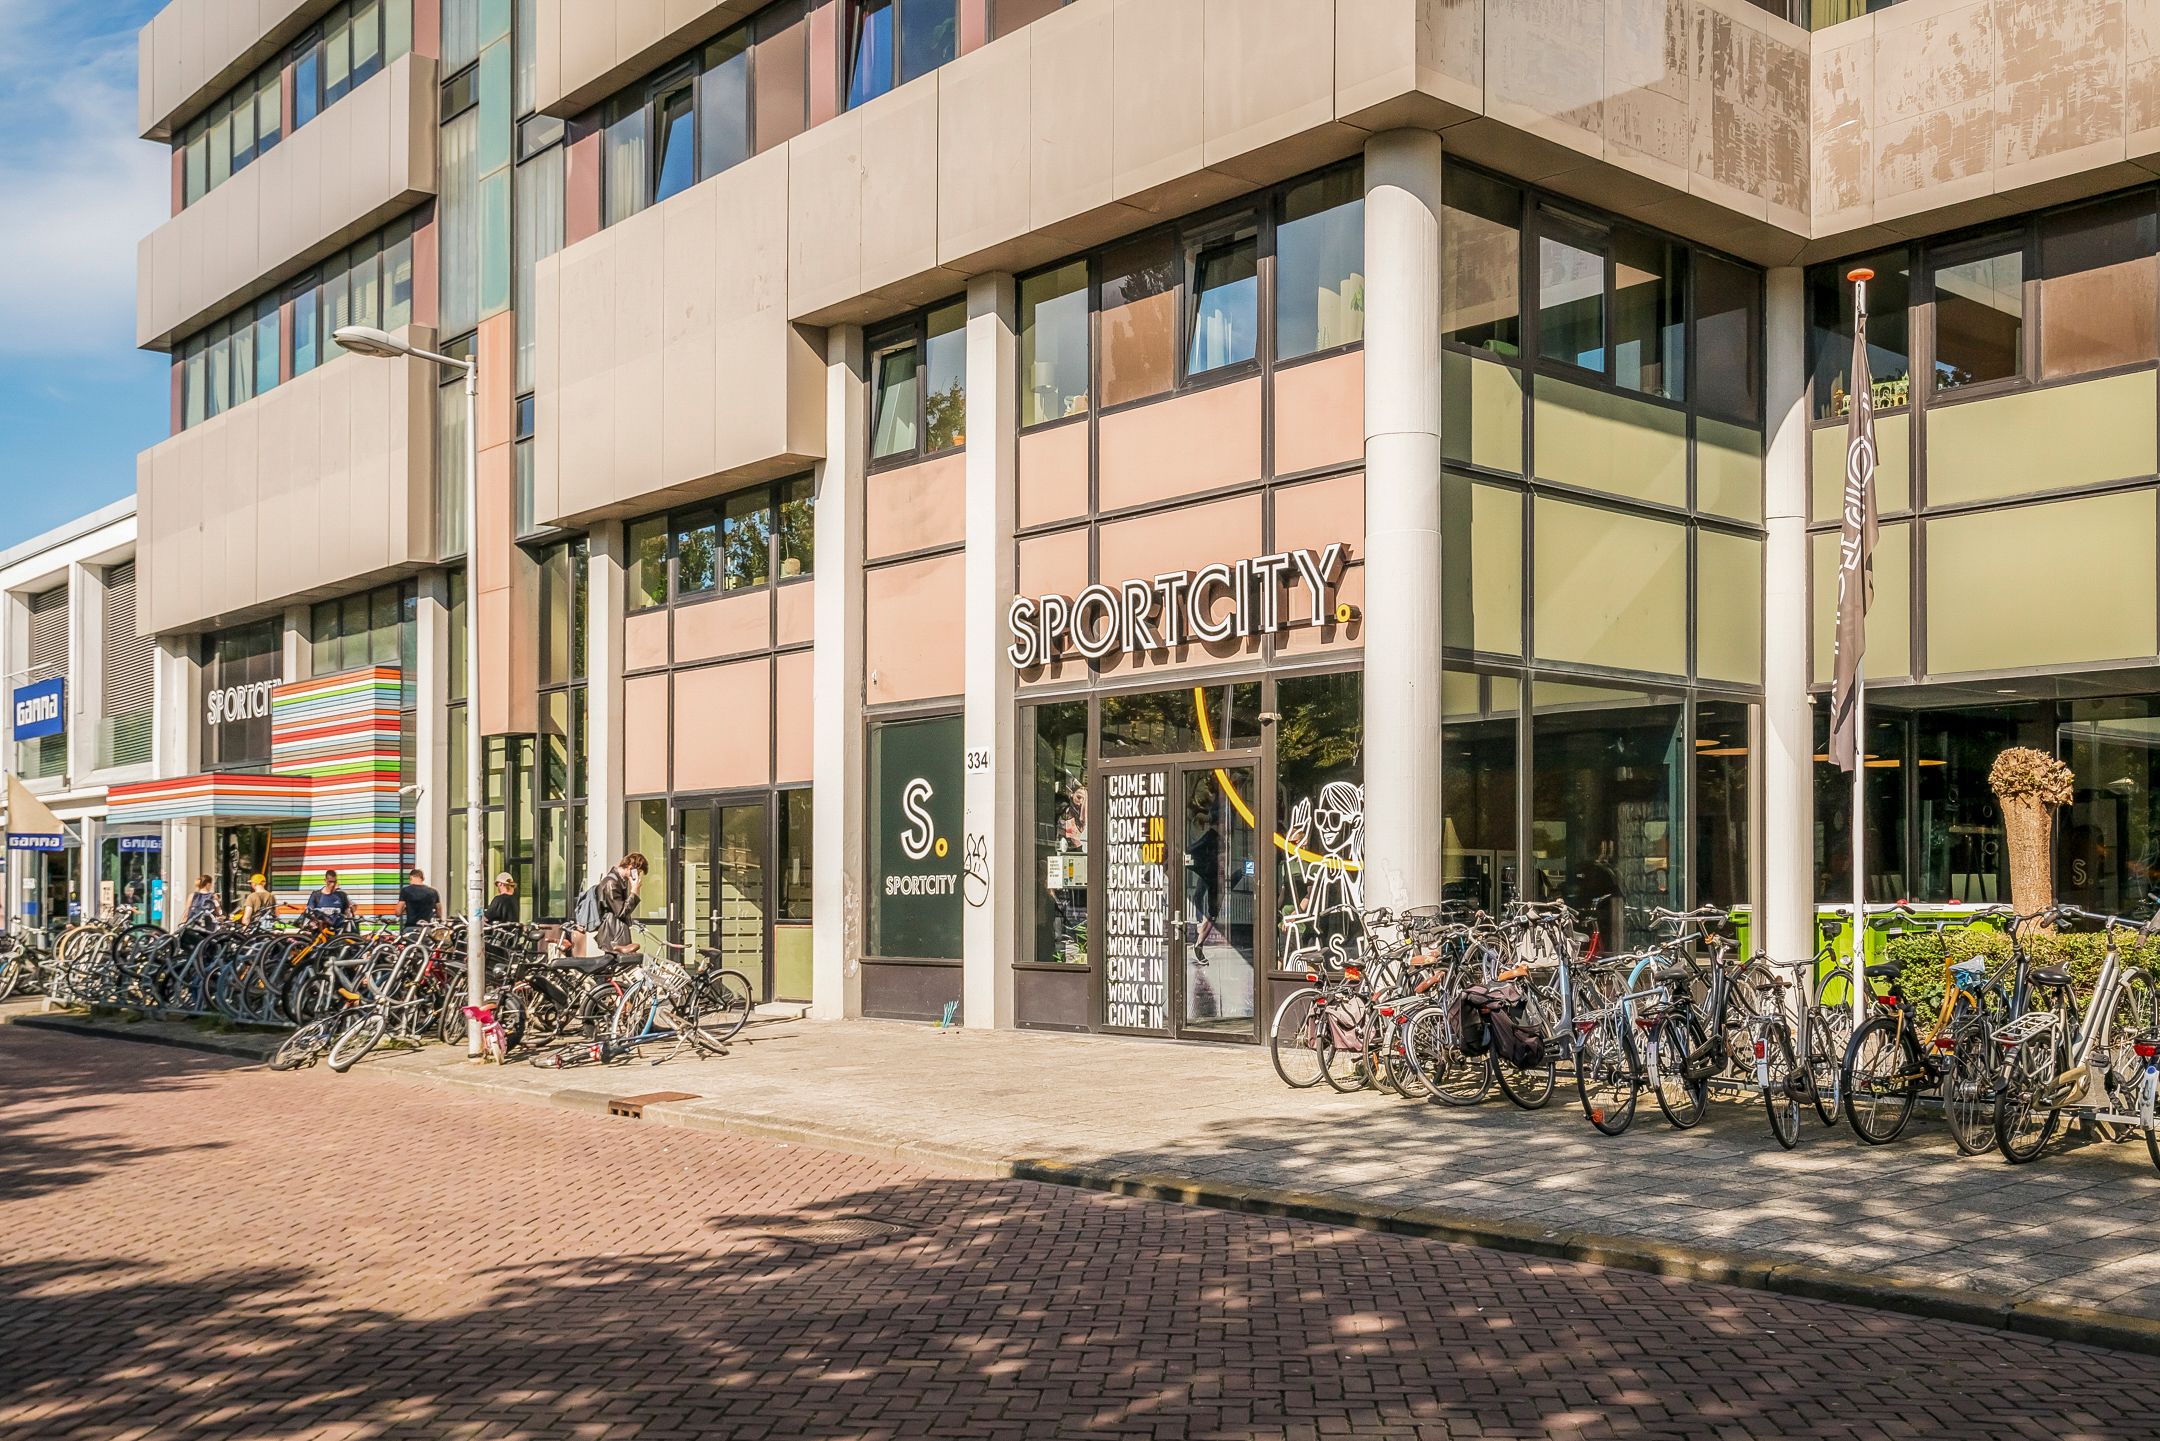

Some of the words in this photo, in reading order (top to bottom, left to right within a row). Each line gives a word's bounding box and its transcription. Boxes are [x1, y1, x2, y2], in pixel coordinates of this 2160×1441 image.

[207, 678, 282, 725] SPORTCI
[967, 751, 989, 770] 334
[1109, 774, 1147, 797] COME
[1150, 772, 1165, 795] IN
[1108, 797, 1140, 818] WORK
[1142, 795, 1165, 817] OUT
[1109, 818, 1147, 843] COME
[1149, 817, 1165, 842] IN
[1108, 843, 1140, 864] WORK
[1142, 843, 1165, 864] OUT
[885, 874, 958, 896] SPORTCITY
[1108, 864, 1147, 889] COME
[1149, 864, 1164, 889] IN
[1107, 889, 1140, 910] WORK
[1142, 890, 1164, 910] OUT
[1108, 911, 1146, 936] COME
[1149, 911, 1163, 936] IN
[1107, 936, 1140, 957] WORK
[1142, 937, 1164, 957] OUT
[1108, 957, 1146, 982] COME
[1149, 958, 1163, 983] IN
[1107, 982, 1140, 1003] WORK
[1141, 983, 1164, 1005] OUT
[1108, 1002, 1146, 1028] COME
[1149, 1005, 1163, 1029] IN
